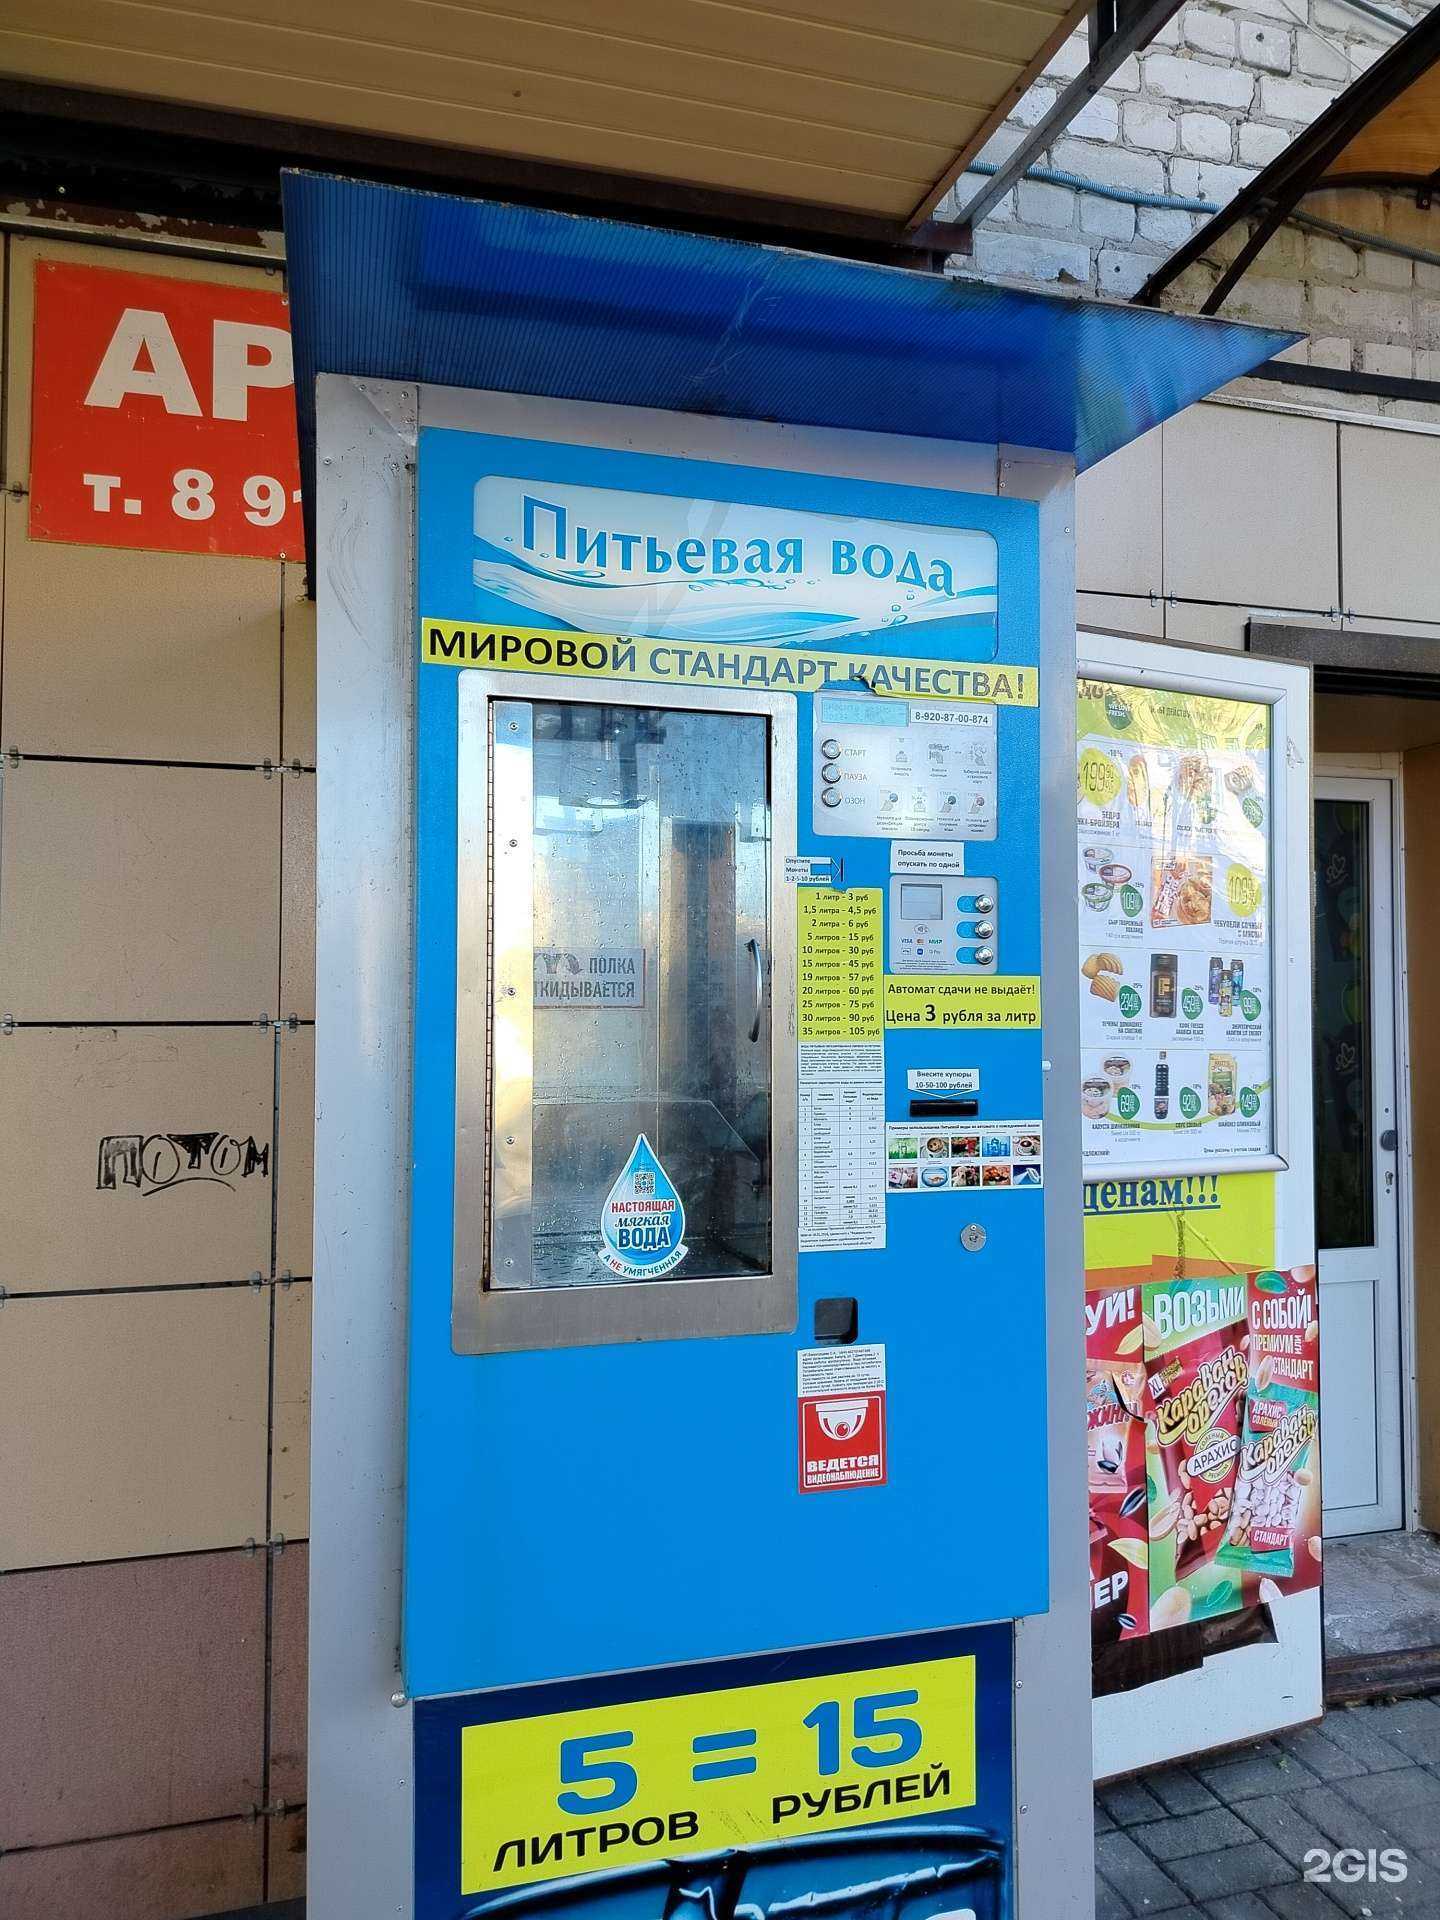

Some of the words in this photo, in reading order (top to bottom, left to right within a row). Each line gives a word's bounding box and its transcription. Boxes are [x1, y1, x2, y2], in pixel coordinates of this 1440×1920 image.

[84, 308, 294, 421] АР
[172, 469, 215, 520] 8
[521, 494, 804, 575] Питьевая
[831, 538, 957, 597] вода
[429, 627, 638, 672] МИРОВОЙ
[649, 647, 838, 688] СТАНДАРТ
[849, 661, 1024, 699] КАЧЕСТВА!
[915, 711, 988, 725] 8-920-87-00-874
[844, 748, 866, 758] СТАРТ
[844, 772, 867, 782] ПАУЗА
[844, 796, 866, 805] ОЗОН
[898, 849, 926, 857] Просьба
[938, 861, 960, 869] одной
[815, 892, 820, 900] 1
[823, 894, 840, 902] литр
[848, 893, 853, 901] 3
[856, 894, 868, 902] руб
[804, 906, 816, 915] 1,5
[848, 906, 861, 915] 4,5
[864, 907, 877, 915] руб
[811, 919, 817, 927] 2
[818, 921, 840, 929] литра
[856, 920, 868, 928] руб
[807, 933, 812, 941] 5
[814, 934, 840, 942] литров
[848, 933, 859, 941] 15
[861, 934, 874, 942] руб
[802, 946, 813, 954] 10
[849, 946, 859, 954] 30
[861, 947, 874, 955] руб
[589, 956, 636, 975] ПОЛКА
[802, 960, 813, 968] 15
[849, 960, 859, 968] 45
[861, 961, 874, 969] руб
[802, 973, 813, 981] 19
[849, 973, 859, 981] 57
[861, 974, 874, 982] руб
[802, 987, 813, 995] 20
[849, 987, 859, 995] 60
[861, 988, 874, 996] руб
[888, 984, 935, 994] Автомат
[938, 986, 971, 995] сдачи
[974, 986, 988, 995] не
[991, 984, 1035, 996] выдаёт!
[802, 1000, 813, 1008] 25
[849, 1000, 859, 1008] 75
[861, 1001, 874, 1009] руб
[802, 1014, 813, 1022] 30
[849, 1014, 859, 1022] 90
[861, 1015, 874, 1023] руб
[886, 1009, 920, 1023] Цена
[925, 1004, 936, 1021] 3
[942, 1009, 983, 1024] рубля
[987, 1013, 1001, 1021] за
[1005, 1012, 1036, 1024] литр
[802, 1028, 813, 1036] 35
[849, 1028, 865, 1036] 105
[867, 1029, 880, 1037] руб
[945, 1071, 972, 1079] купюры
[948, 1081, 973, 1089] рублей
[611, 1200, 675, 1214] НАСТОЯЩАЯ
[614, 1215, 670, 1228] мягкая
[618, 1227, 670, 1249] ВОДА
[603, 1254, 610, 1262] А
[609, 1259, 623, 1270] НЕ
[623, 1250, 682, 1277] УМЯГЧЕННАЯ
[1153, 1285, 1245, 1338] ВОЗЬМИ
[1251, 1301, 1262, 1330] С
[1263, 1291, 1312, 1330] СОБОЙ!
[1252, 1333, 1293, 1354] ПРЕМИУМ
[1272, 1359, 1314, 1381] СТАНДАРТ
[1150, 1375, 1164, 1396] XL
[1155, 1348, 1237, 1433] Караван
[1251, 1401, 1282, 1418] АРАХИС
[1241, 1406, 1307, 1471] Караван
[807, 1454, 880, 1473] ВЕДЕТСЯ
[1193, 1438, 1238, 1472] АРАХИС
[807, 1467, 880, 1485] ВИДЕОНАБЛЮДЕНИЕ
[1253, 1529, 1289, 1547] СТАНДАРТ
[1090, 1570, 1129, 1609] ЕР
[556, 1730, 639, 1815] 5
[802, 1688, 923, 1777] 15
[492, 1809, 700, 1873] ЛИТРОВ
[772, 1762, 951, 1824] РУБЛЕЙ
